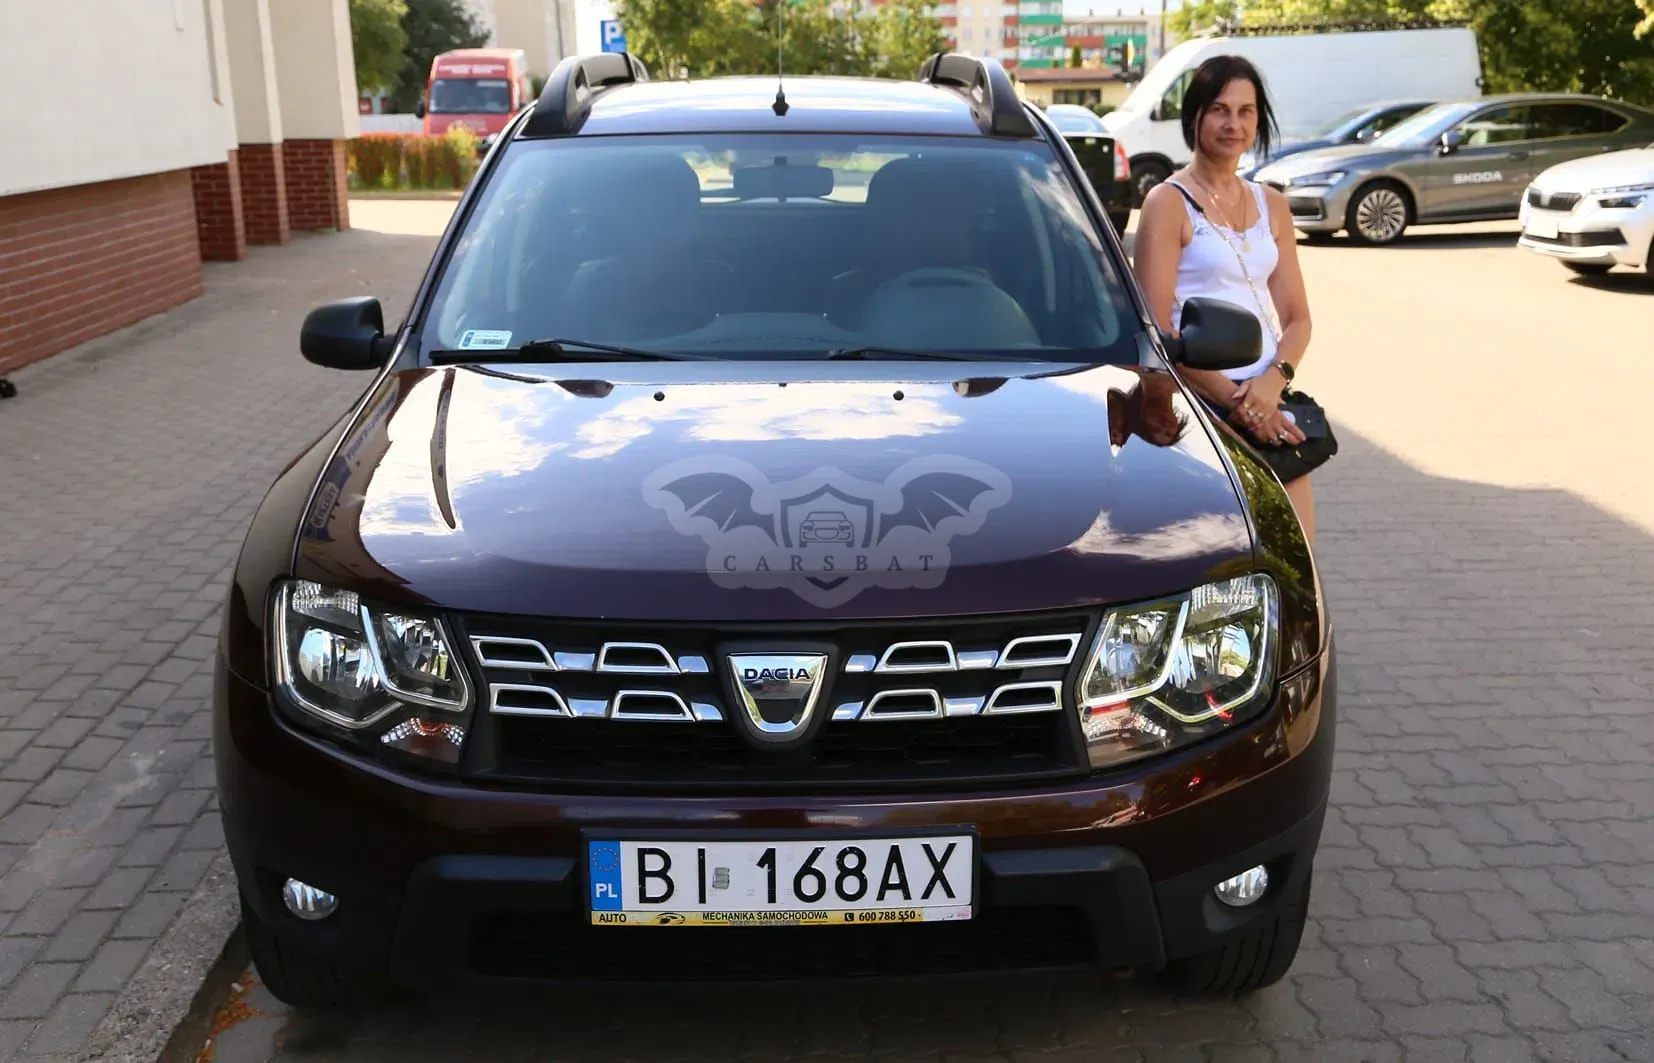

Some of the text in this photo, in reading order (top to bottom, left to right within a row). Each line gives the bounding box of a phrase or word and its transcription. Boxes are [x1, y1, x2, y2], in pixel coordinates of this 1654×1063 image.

[604, 21, 622, 46] P
[744, 668, 811, 680] DACIA
[637, 842, 957, 905] BI 168AX
[595, 883, 618, 898] PL
[598, 910, 916, 923] AUTO MECHANIKA SAMOCHODOWA 600 788 550
